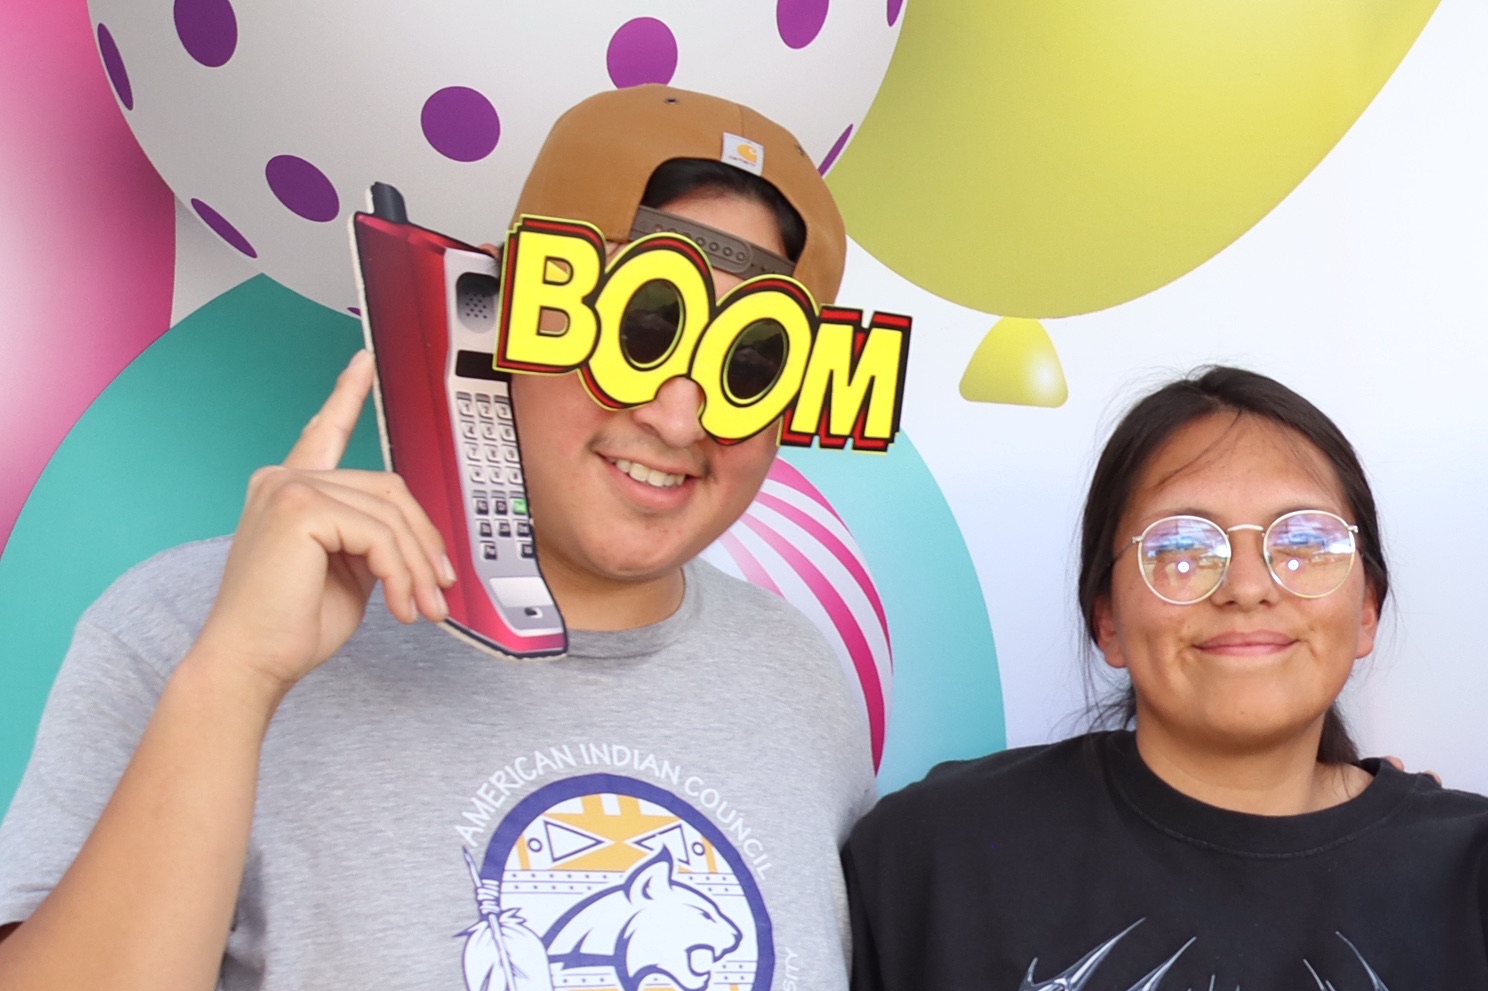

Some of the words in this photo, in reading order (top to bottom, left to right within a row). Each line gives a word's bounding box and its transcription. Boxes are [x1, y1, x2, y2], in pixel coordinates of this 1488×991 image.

[498, 220, 909, 449] BOOM
[454, 743, 578, 848] AMERICAN
[579, 743, 681, 785] INDIAN
[683, 775, 773, 881] COUNCIL
